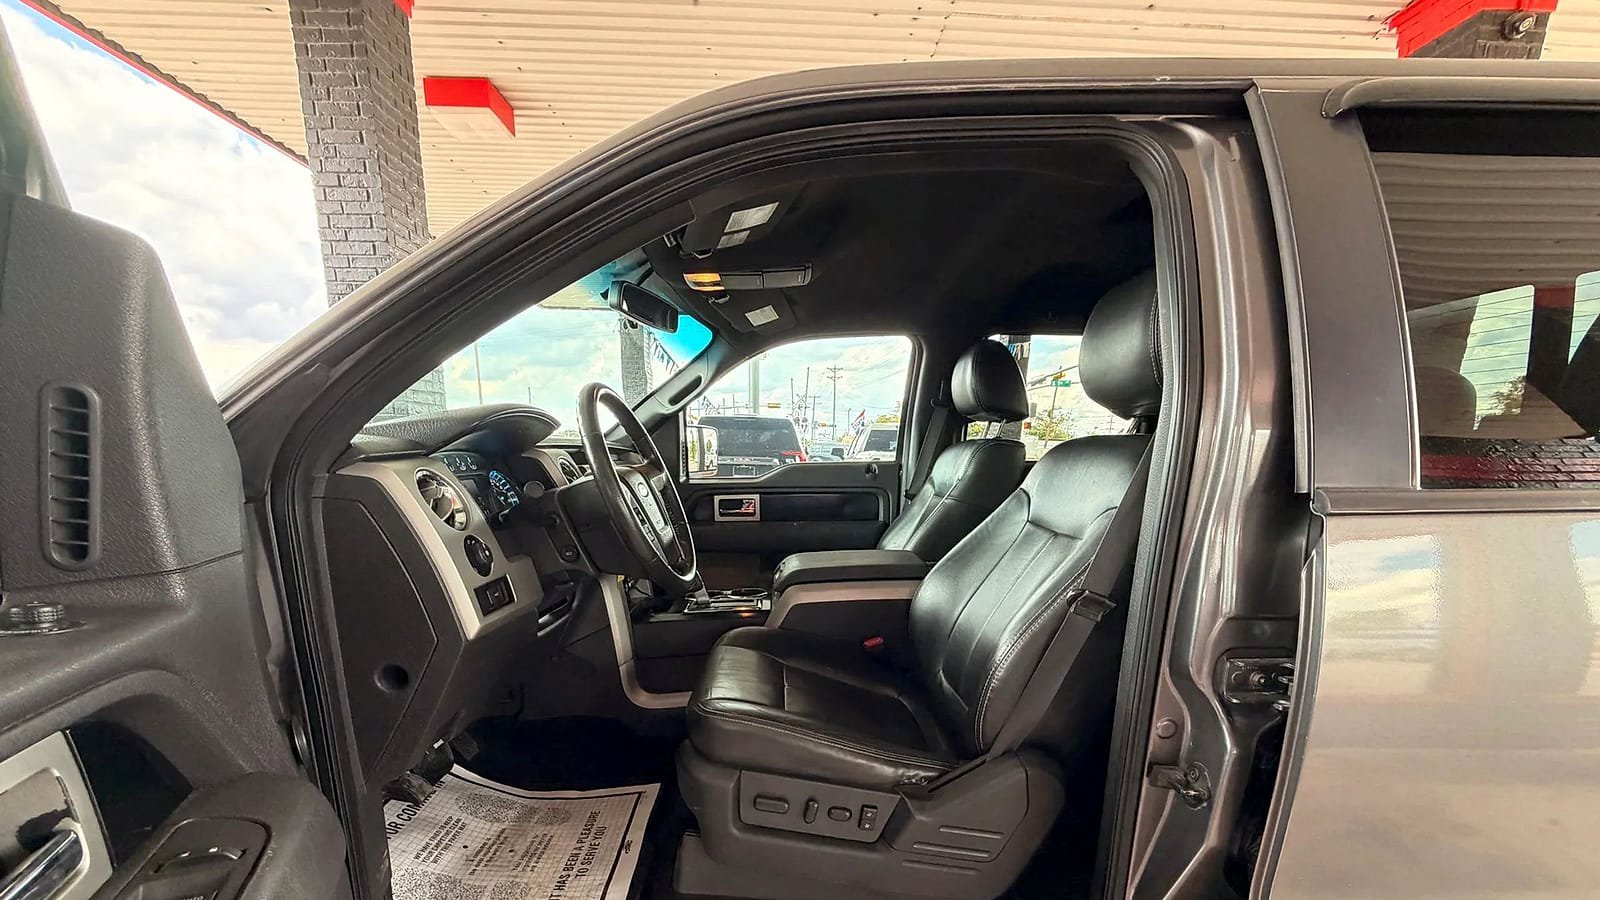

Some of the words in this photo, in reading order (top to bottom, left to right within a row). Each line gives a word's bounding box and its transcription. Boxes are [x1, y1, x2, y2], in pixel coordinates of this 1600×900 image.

[592, 826, 607, 842] YOU
[553, 874, 571, 891] HAS
[562, 852, 581, 872] BEEN
[576, 810, 601, 845] PLEASURE
[580, 841, 601, 866] SERVE
[575, 867, 589, 879] TO
